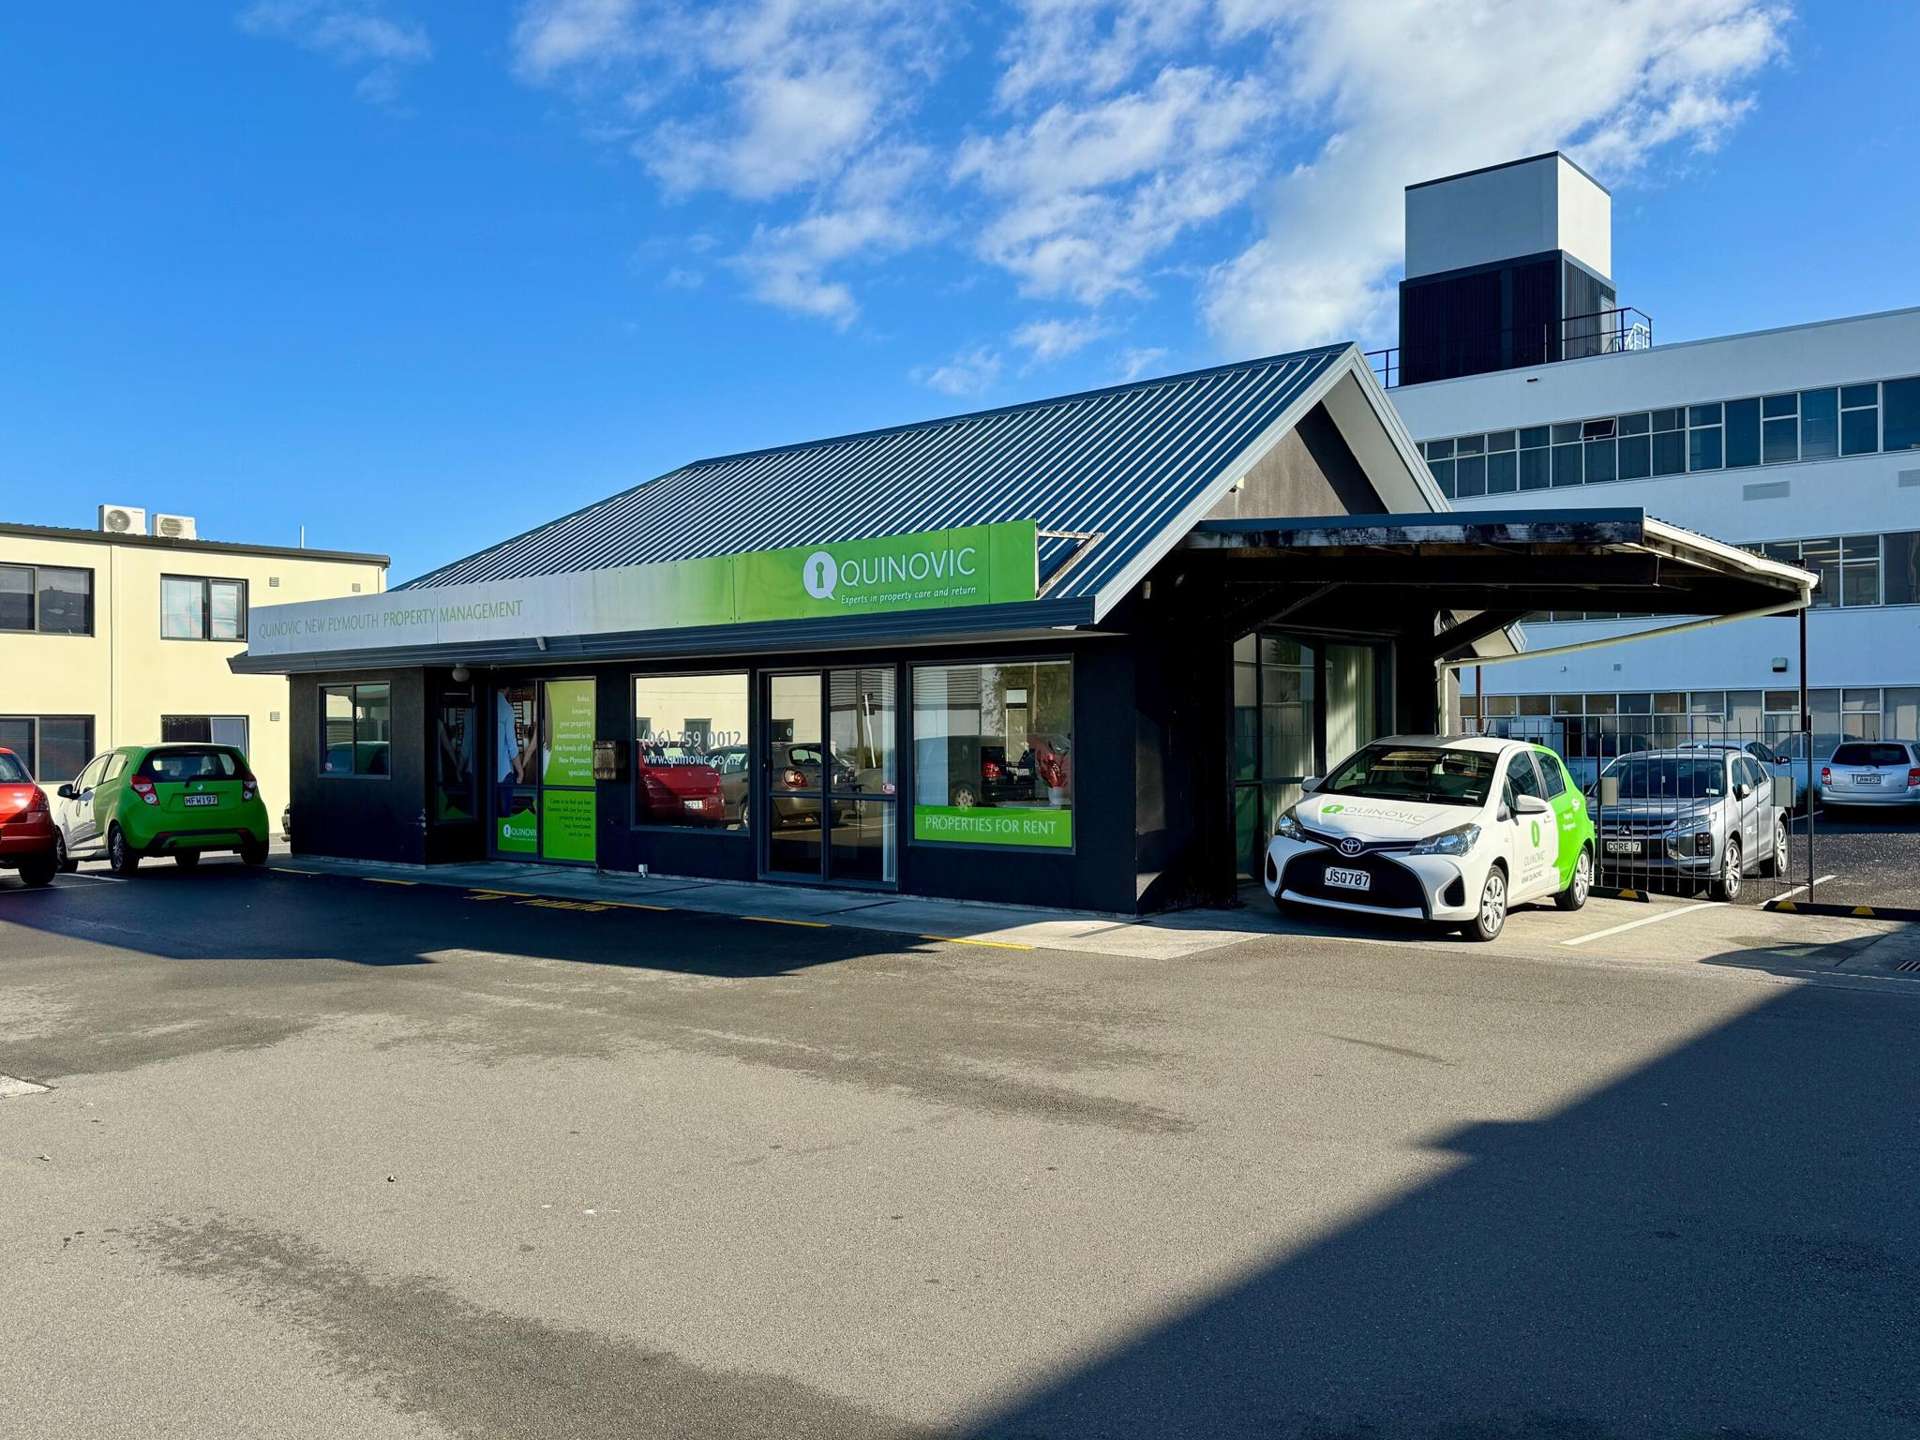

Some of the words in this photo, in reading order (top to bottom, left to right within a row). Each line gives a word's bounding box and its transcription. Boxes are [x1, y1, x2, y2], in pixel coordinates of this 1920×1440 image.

[841, 548, 976, 587] QUINOVIC
[842, 594, 867, 606] Experts
[870, 594, 877, 602] in
[880, 592, 912, 603] property
[915, 589, 931, 599] care
[934, 587, 948, 597] and
[952, 585, 976, 596] return
[259, 620, 301, 639] QUINOVIC
[305, 617, 325, 633] NEW
[328, 613, 379, 632] PLYMOUTH
[384, 608, 436, 626] PROPERTY
[440, 600, 523, 623] MANAGEMENT
[642, 729, 670, 750] (06)
[677, 731, 701, 748] 759
[707, 731, 741, 747] 0012
[926, 815, 992, 832] PROPERTIES
[996, 819, 1019, 833] FOR
[1023, 820, 1056, 834] RENT
[1345, 806, 1425, 823] QUINOVIC
[1327, 870, 1369, 887] JSQ707
